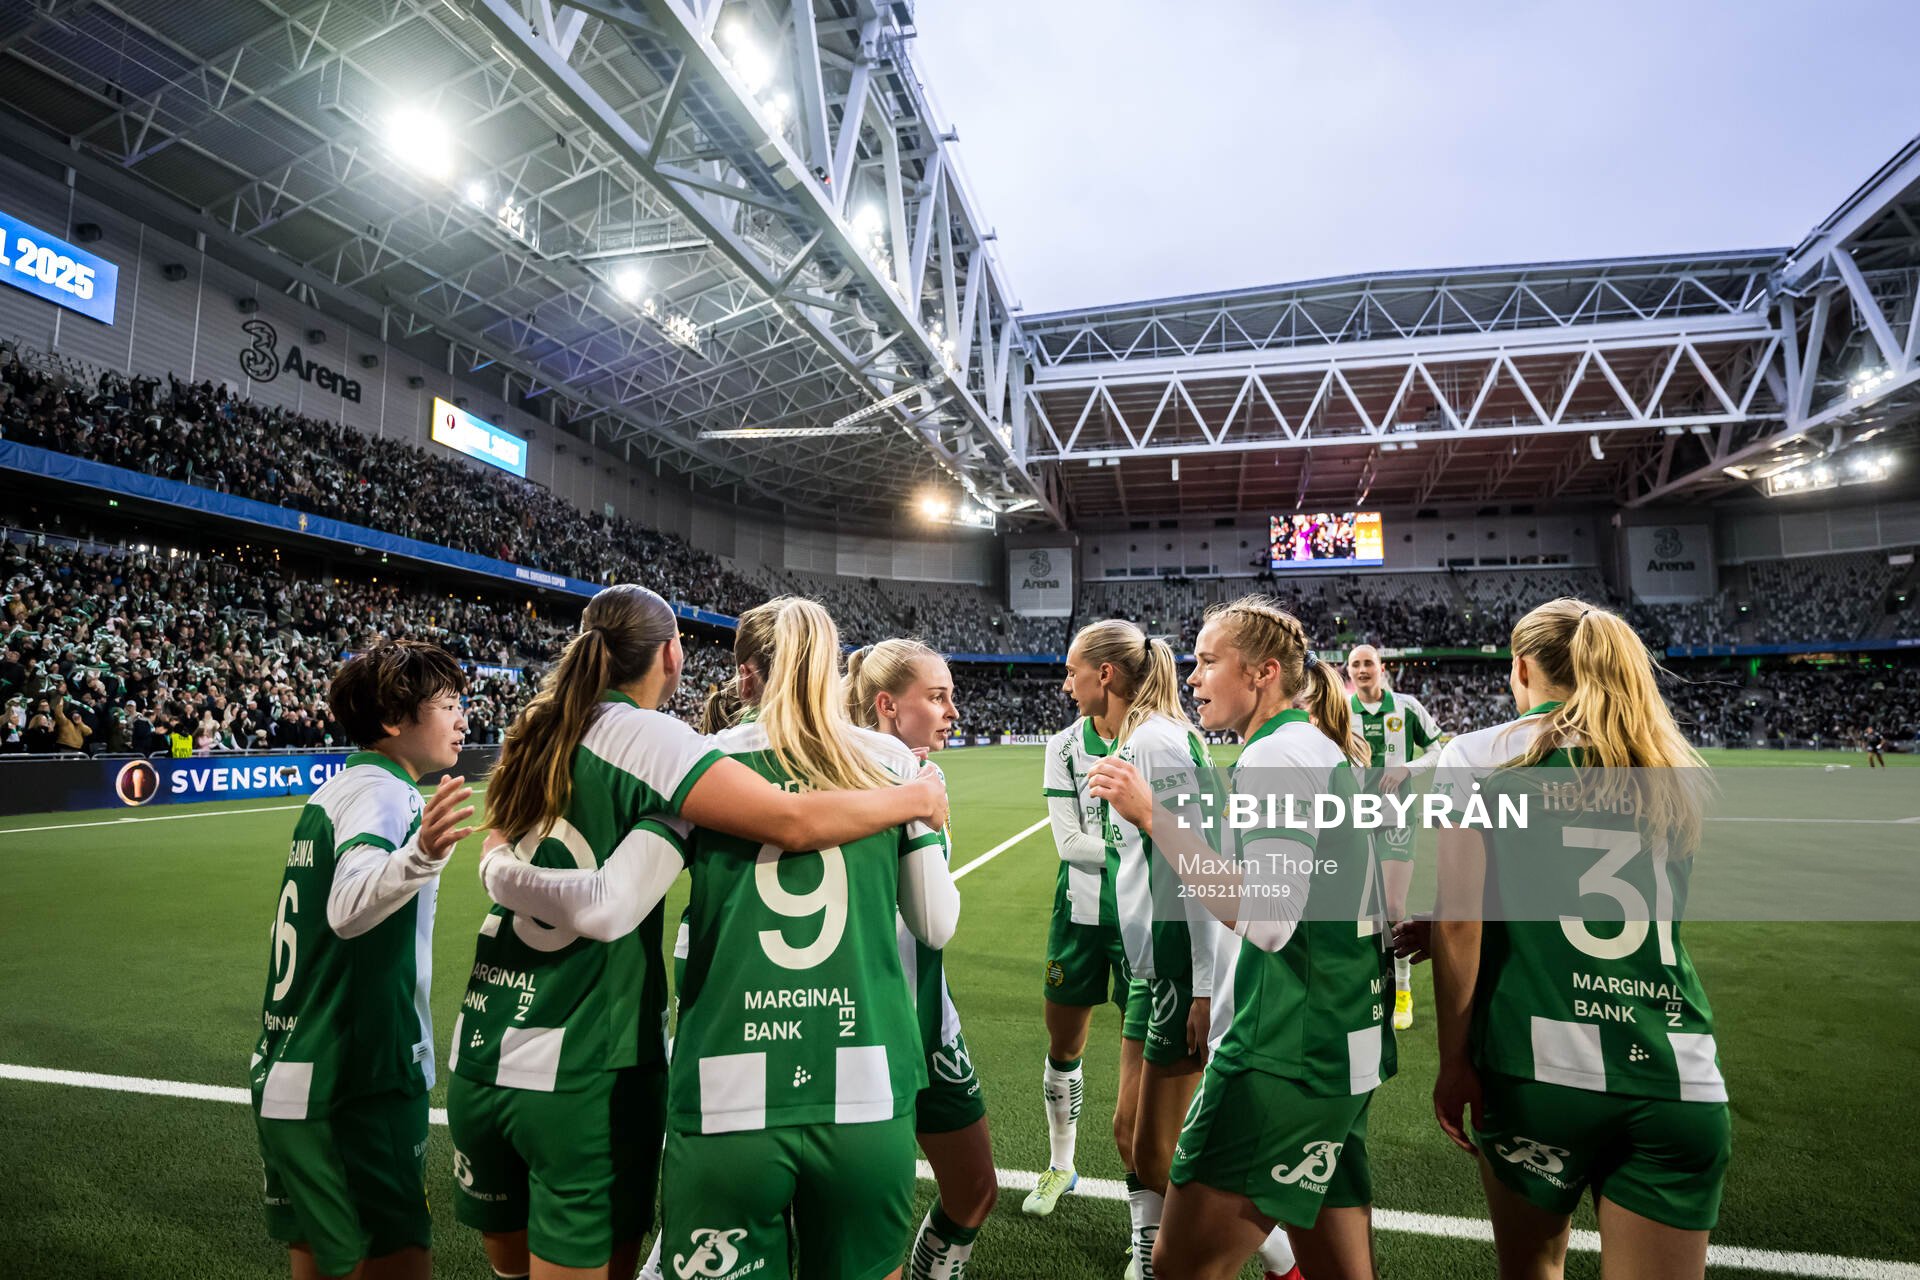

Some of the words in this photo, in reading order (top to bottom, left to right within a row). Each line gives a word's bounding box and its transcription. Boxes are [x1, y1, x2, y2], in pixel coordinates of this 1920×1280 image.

[15, 237, 95, 300] 2025
[282, 345, 361, 404] Arena
[1646, 560, 1696, 573] Arena
[1022, 579, 1060, 590] Arena
[171, 766, 303, 794] SVENSKA
[1151, 772, 1188, 794] BST
[1542, 781, 1650, 818] HOLMB
[754, 840, 849, 970] 9
[1558, 826, 1677, 966] 31
[472, 961, 536, 992] ARGINAL
[1572, 971, 1683, 1001] MARGINAL
[464, 989, 489, 1013] ANK
[744, 987, 856, 1010] MARGINAL
[1574, 999, 1637, 1024] BANK
[744, 1020, 803, 1042] BANK
[753, 1258, 765, 1272] AB
